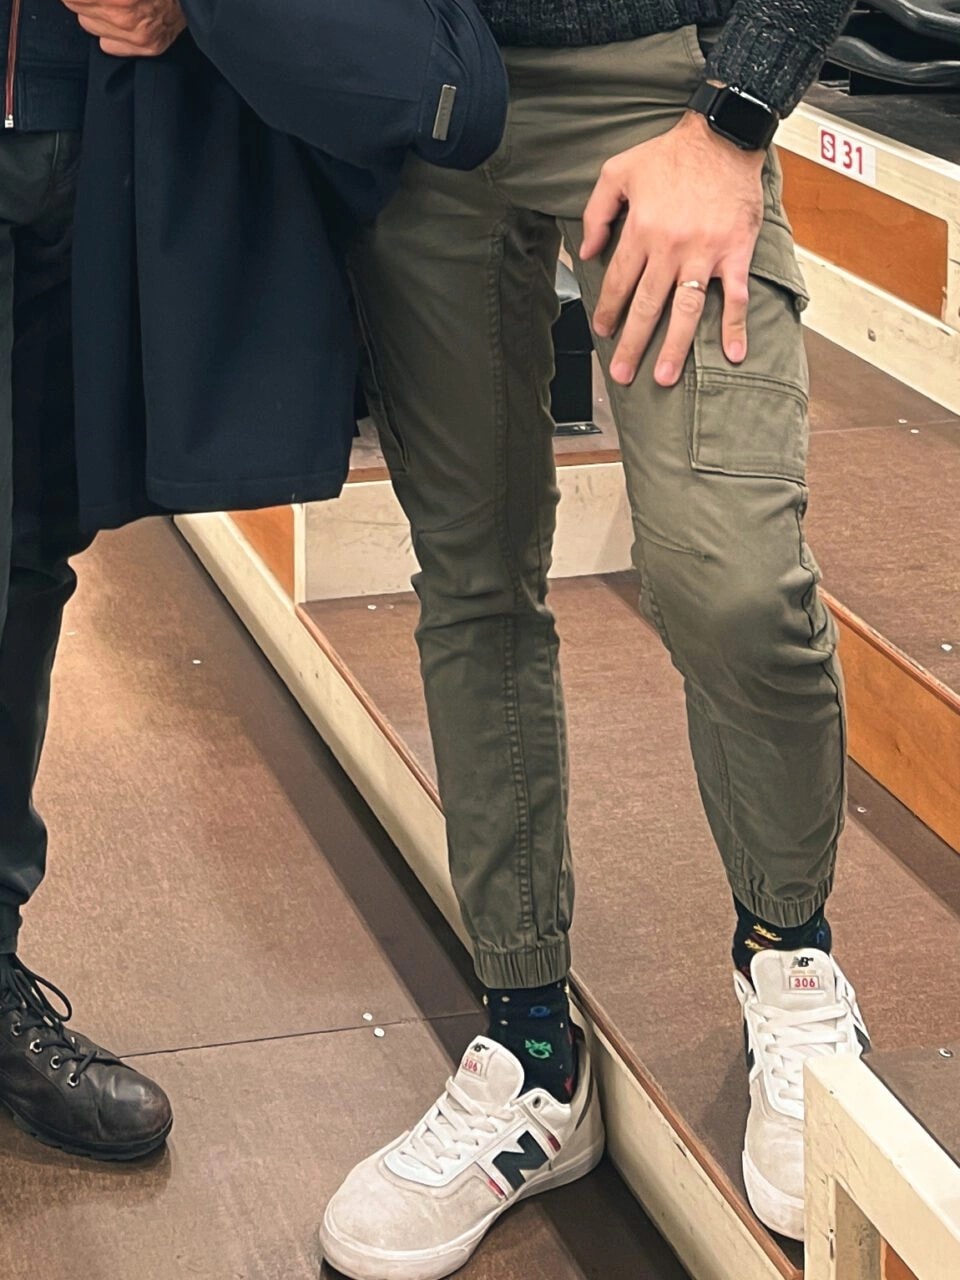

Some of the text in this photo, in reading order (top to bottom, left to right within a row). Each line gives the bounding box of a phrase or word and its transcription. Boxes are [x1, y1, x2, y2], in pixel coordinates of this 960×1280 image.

[821, 129, 863, 175] S 31
[794, 977, 816, 988] 306
[491, 1129, 549, 1192] N
